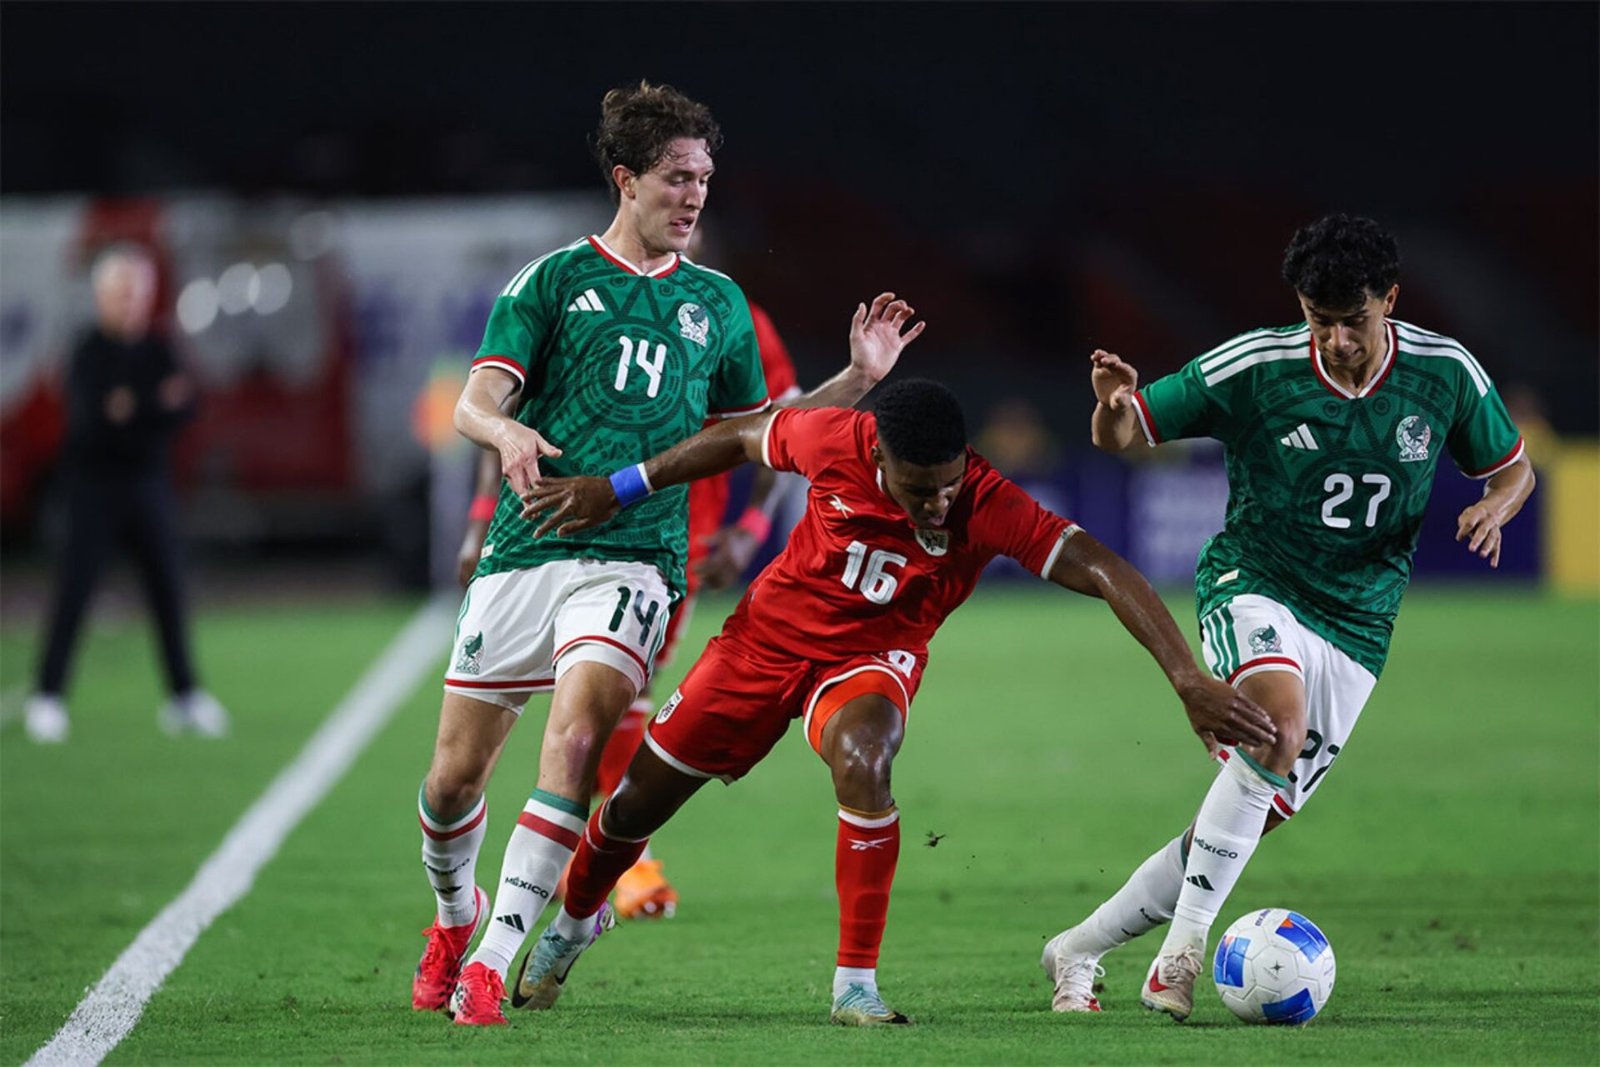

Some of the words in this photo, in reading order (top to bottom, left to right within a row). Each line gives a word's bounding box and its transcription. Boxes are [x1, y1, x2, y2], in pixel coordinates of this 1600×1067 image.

[614, 335, 667, 398] 14
[1321, 473, 1391, 529] 27
[841, 540, 908, 605] 16
[608, 586, 659, 647] 14
